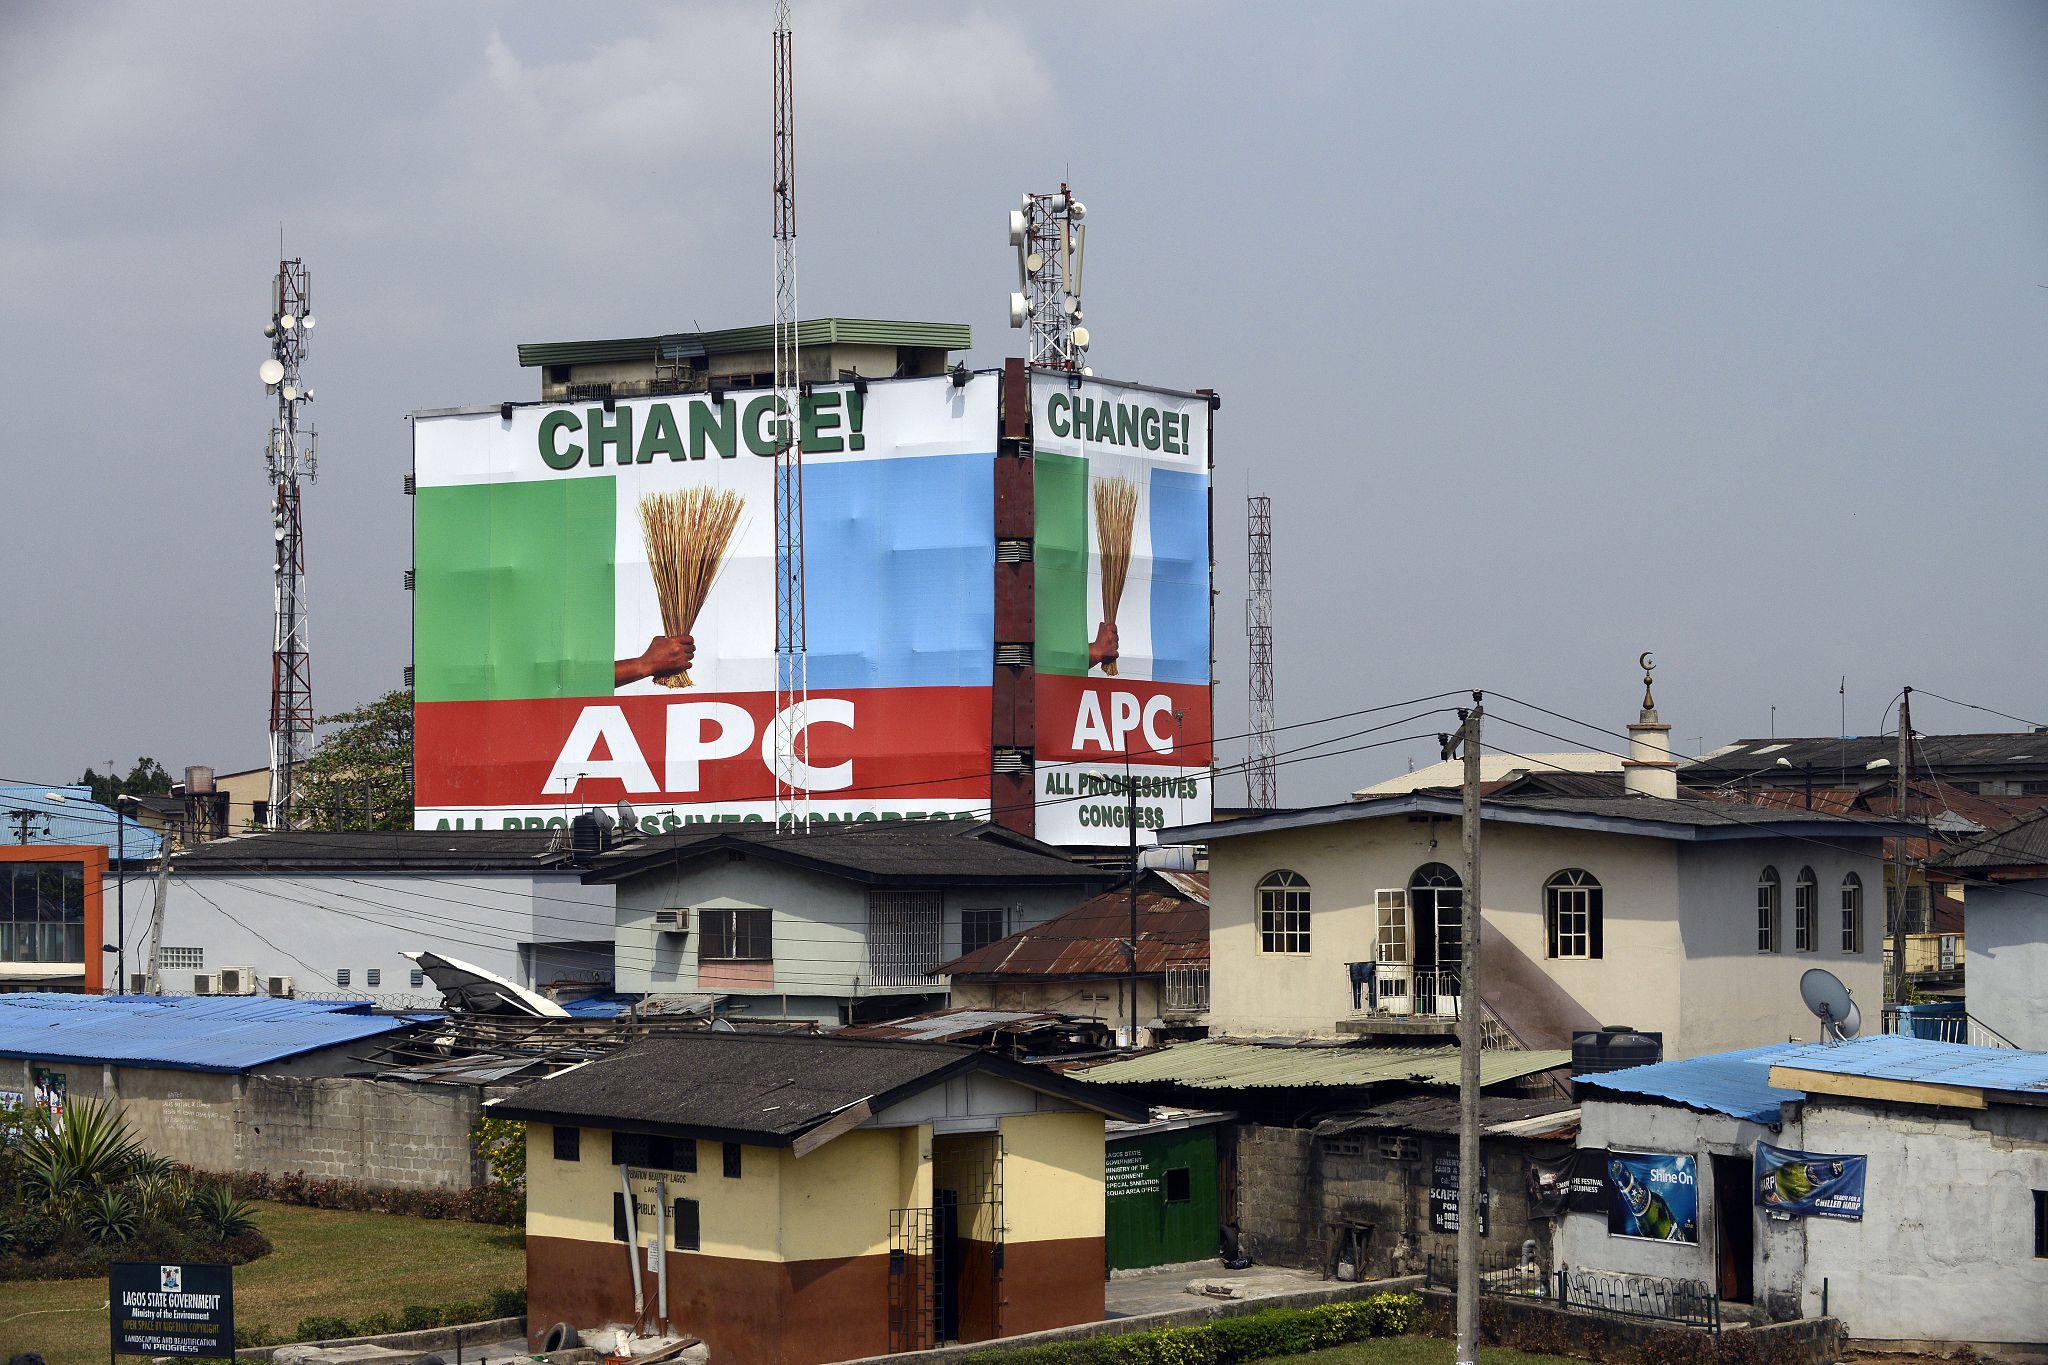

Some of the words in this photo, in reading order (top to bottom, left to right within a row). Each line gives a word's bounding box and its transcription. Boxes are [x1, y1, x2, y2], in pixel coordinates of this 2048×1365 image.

[538, 390, 866, 470] CHANGE!
[1048, 393, 1190, 456] CHANGE!
[1071, 689, 1174, 755] APC
[541, 698, 855, 795] APC
[1045, 773, 1074, 795] ALL
[1078, 772, 1198, 800] PROGRESSIVES
[1581, 1178, 1604, 1187] FESTIVAL
[1650, 1168, 1677, 1184] Shine
[1678, 1171, 1693, 1185] On
[637, 1202, 657, 1216] PUBLIC
[1442, 1202, 1457, 1211] FOR
[1814, 1198, 1842, 1209] CHILLED
[1842, 1201, 1861, 1210] HARP
[122, 1290, 146, 1307] LAGOS
[147, 1292, 168, 1308] STATE
[168, 1293, 220, 1310] GOVERNMENT
[131, 1308, 156, 1320] Ministry
[156, 1308, 163, 1318] of
[163, 1308, 172, 1318] the
[173, 1309, 210, 1320] Environment
[124, 1334, 161, 1344] LANDSCAPING
[161, 1336, 173, 1344] AND
[173, 1337, 217, 1347] BEAUTIFICATION
[153, 1343, 199, 1353] PROGRESS
